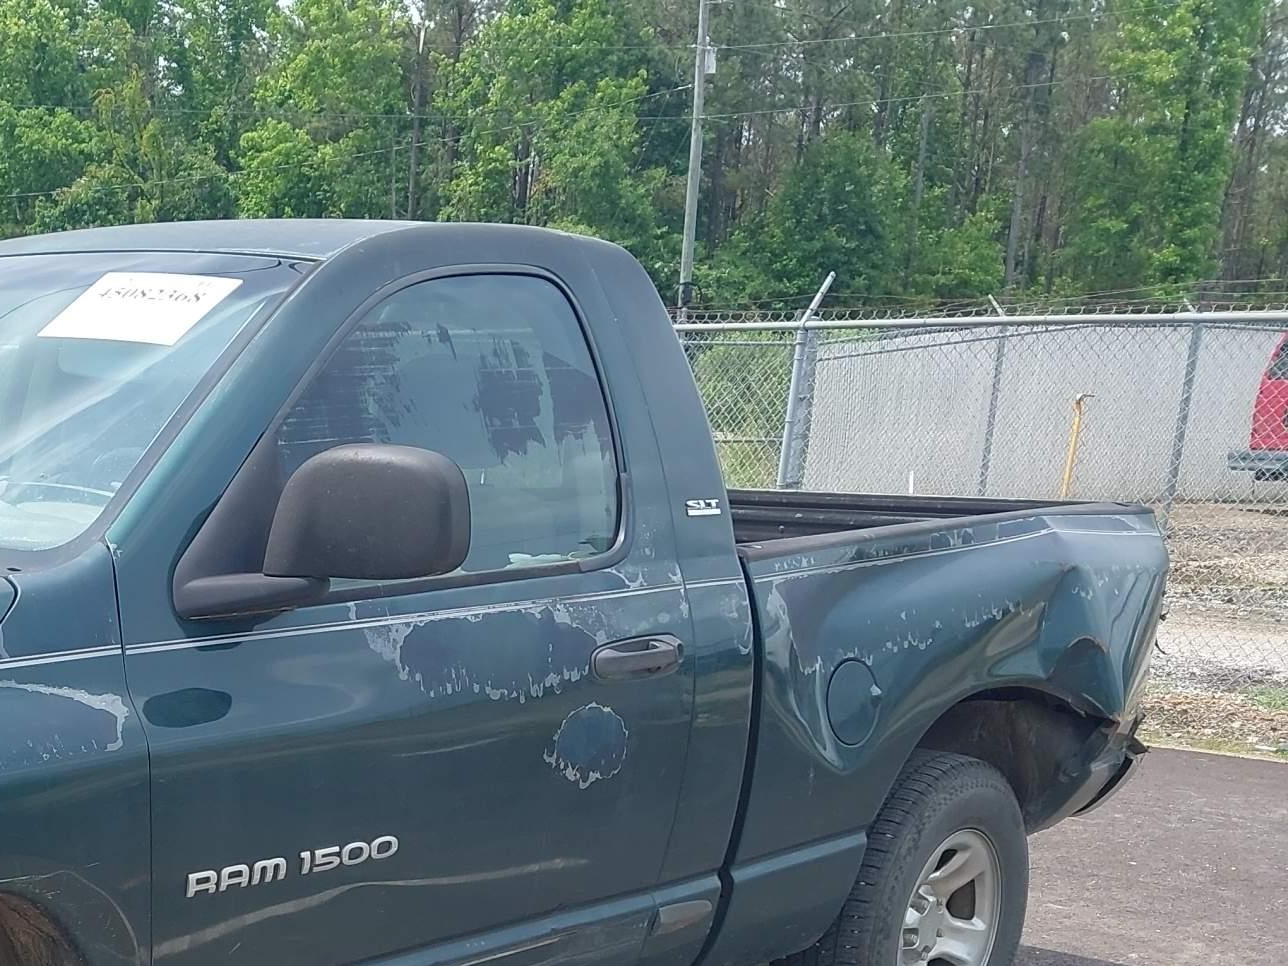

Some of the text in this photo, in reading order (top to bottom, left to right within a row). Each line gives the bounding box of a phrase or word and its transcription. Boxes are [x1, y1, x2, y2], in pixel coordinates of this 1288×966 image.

[685, 498, 720, 510] SLT
[185, 835, 399, 898] RAM 1500
